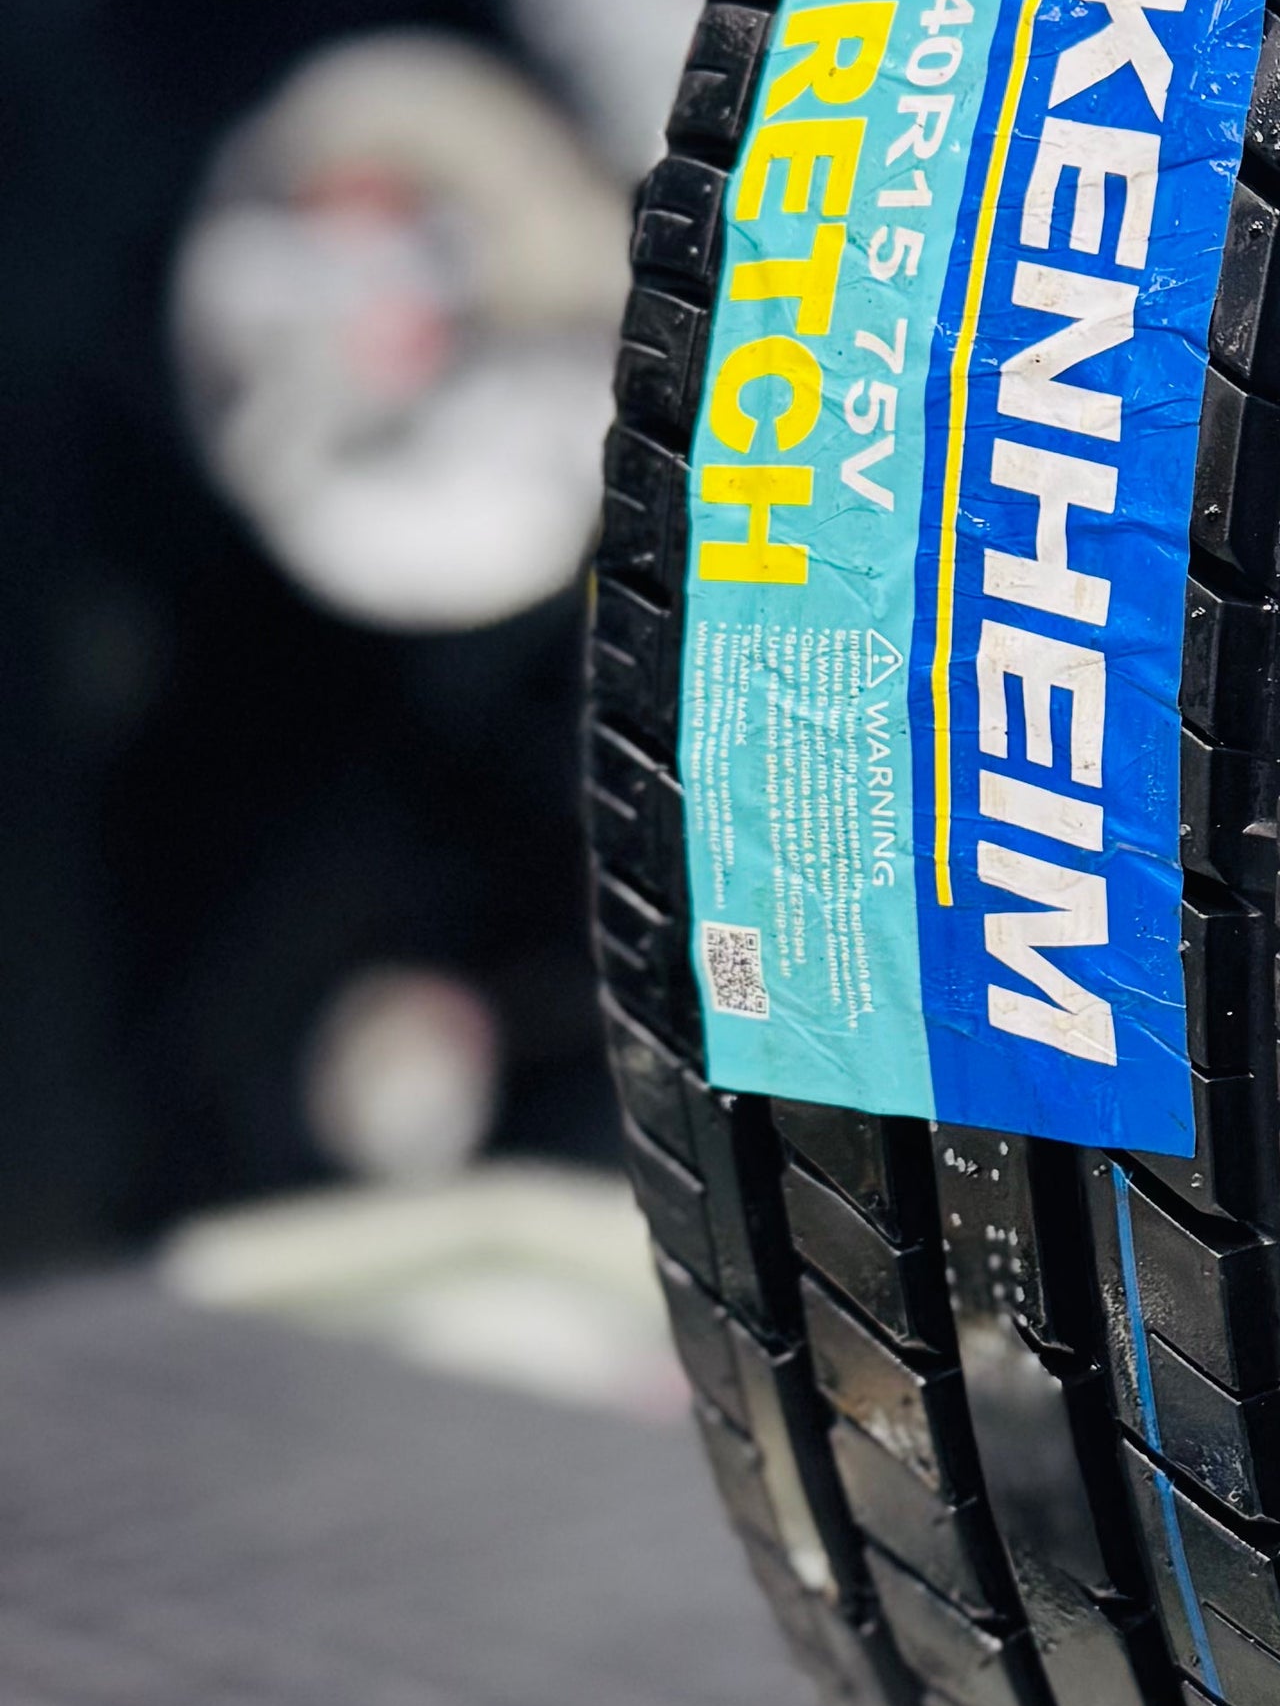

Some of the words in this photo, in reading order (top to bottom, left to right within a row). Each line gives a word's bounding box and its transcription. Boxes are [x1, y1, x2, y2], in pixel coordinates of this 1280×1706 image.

[840, 318, 908, 512] 75V
[694, 620, 709, 666] While
[711, 632, 726, 682] Never
[752, 623, 765, 672] chuck
[767, 636, 780, 669] Use
[833, 629, 846, 691] Serious
[848, 630, 861, 704] Improper
[691, 669, 707, 727] seating
[709, 684, 724, 734] inflate
[724, 687, 736, 720] with
[690, 731, 706, 779] beads
[705, 736, 719, 785] above
[765, 753, 781, 804] gauge
[817, 764, 830, 790] rim
[833, 748, 846, 801] Follow
[720, 779, 733, 822] valve
[784, 776, 797, 819] valve
[847, 787, 859, 816] can
[867, 701, 896, 887] WARNING
[785, 822, 799, 839] at
[818, 794, 832, 865] diameter
[773, 865, 788, 898] with
[821, 868, 834, 901] with
[834, 858, 850, 932] Mounting
[851, 873, 866, 899] tire
[852, 903, 871, 978] explosion
[779, 957, 792, 979] air
[861, 982, 875, 1013] and
